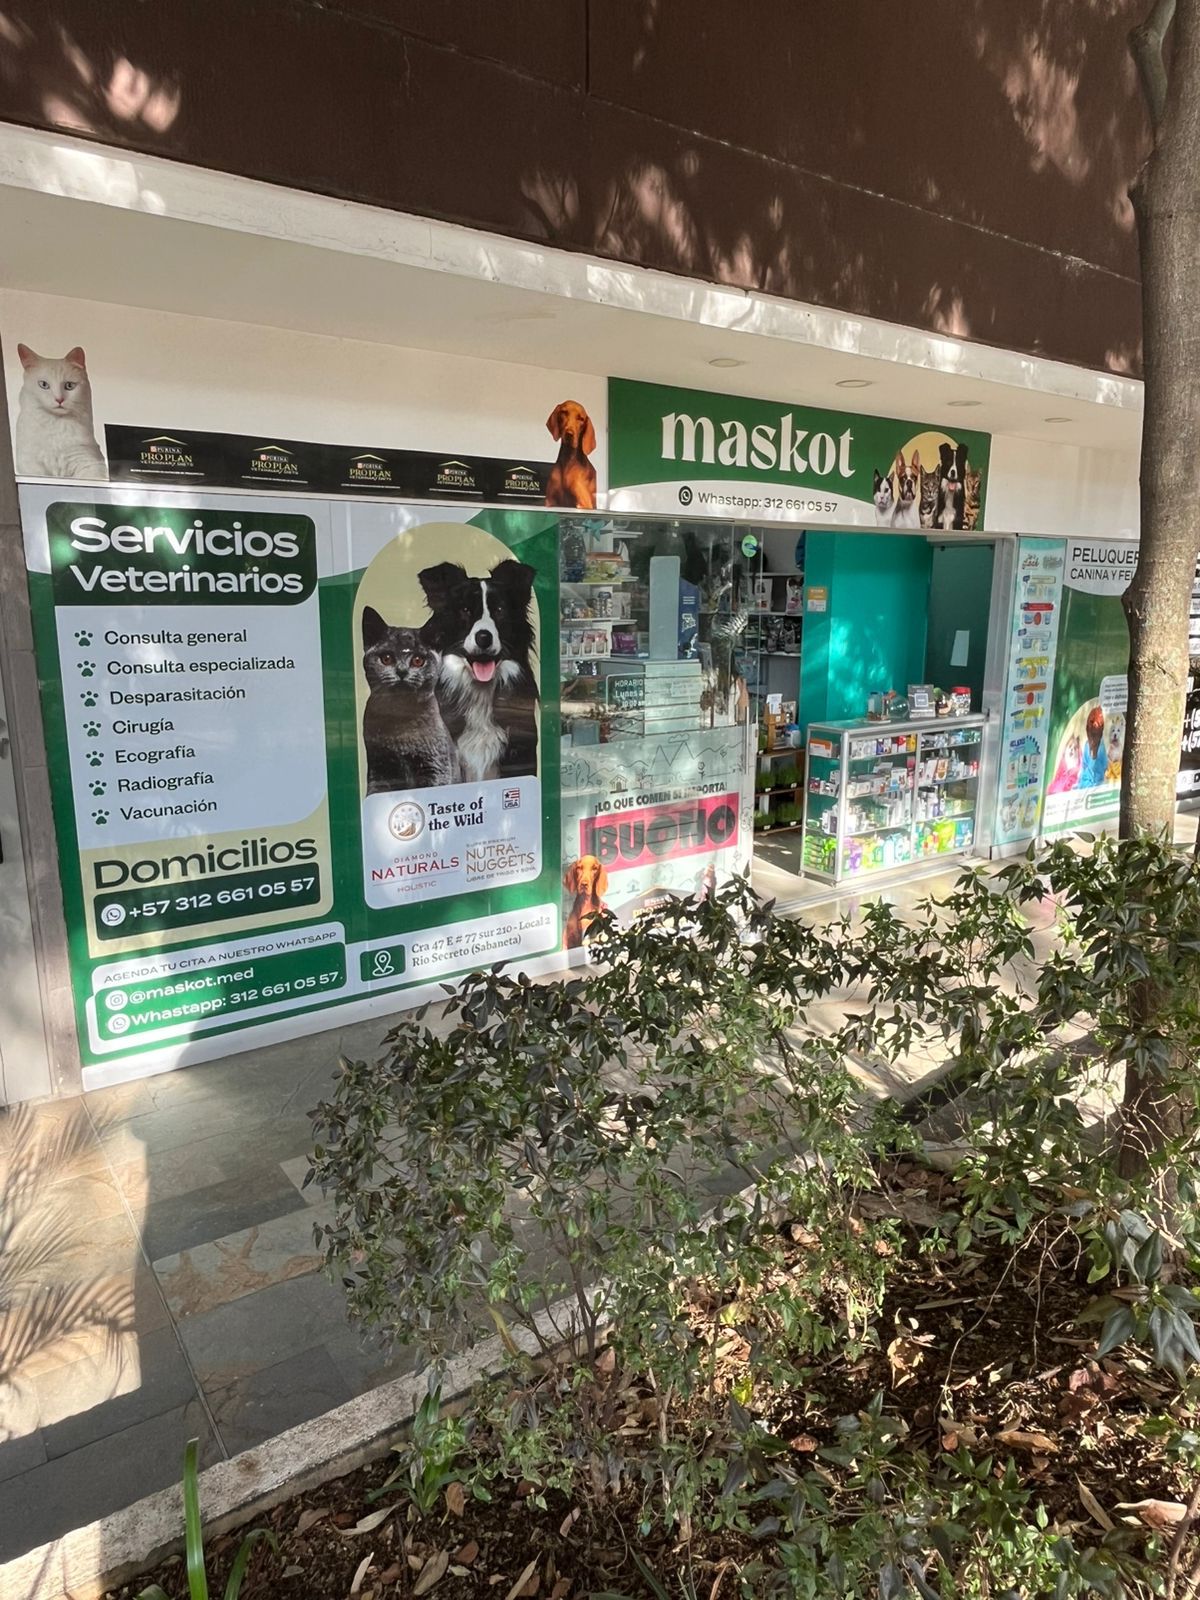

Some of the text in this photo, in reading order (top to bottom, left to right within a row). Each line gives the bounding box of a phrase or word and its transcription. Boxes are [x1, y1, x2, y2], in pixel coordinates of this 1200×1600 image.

[660, 412, 856, 478] maskot
[698, 492, 838, 513] Whastapp: 312 661 05 57
[70, 516, 300, 559] Servicios
[69, 564, 304, 594] Veterinarios
[1070, 568, 1111, 580] CANINA
[1111, 569, 1117, 580] Y
[104, 629, 247, 650] Consulta general
[107, 656, 296, 677] Consulta especializada
[110, 687, 246, 707] Desparasitación
[112, 718, 175, 737] Cirugía
[115, 745, 196, 765] Ecografía
[117, 772, 215, 793] Radiografía
[120, 800, 218, 821] Vacunación
[428, 797, 484, 816] Taste of
[595, 801, 611, 815] ¡LO
[613, 797, 634, 810] QUE
[636, 791, 670, 806] COMEN
[428, 812, 484, 831] the Wild
[592, 805, 736, 866] BUONO
[93, 837, 319, 890] Domicilios
[393, 851, 438, 863] DIAMOND
[466, 844, 520, 862] NUTRA-
[466, 852, 535, 875] NUGGETS
[371, 856, 460, 881] NATURALS
[129, 877, 316, 918] +57 312 661 05 57
[397, 881, 437, 893] HOLISTIC
[411, 942, 430, 954] Cra
[431, 940, 445, 951] 47
[446, 936, 454, 946] E
[465, 933, 477, 944] 77
[478, 930, 495, 940] sur
[496, 925, 512, 936] 210
[519, 917, 543, 930] Local
[545, 917, 550, 925] 2
[103, 965, 159, 984] AGENDA
[160, 962, 177, 972] TU
[179, 957, 206, 969] CITA
[218, 944, 274, 961] NUESTRO
[275, 932, 337, 950] WHATSAPP
[412, 935, 522, 967] Rio Secreto (Sabaneta)
[129, 967, 255, 1005] @maskot.med
[130, 997, 226, 1026] Whastapp:
[230, 991, 258, 1005] 312
[261, 983, 291, 998] 661
[293, 976, 316, 990] 05
